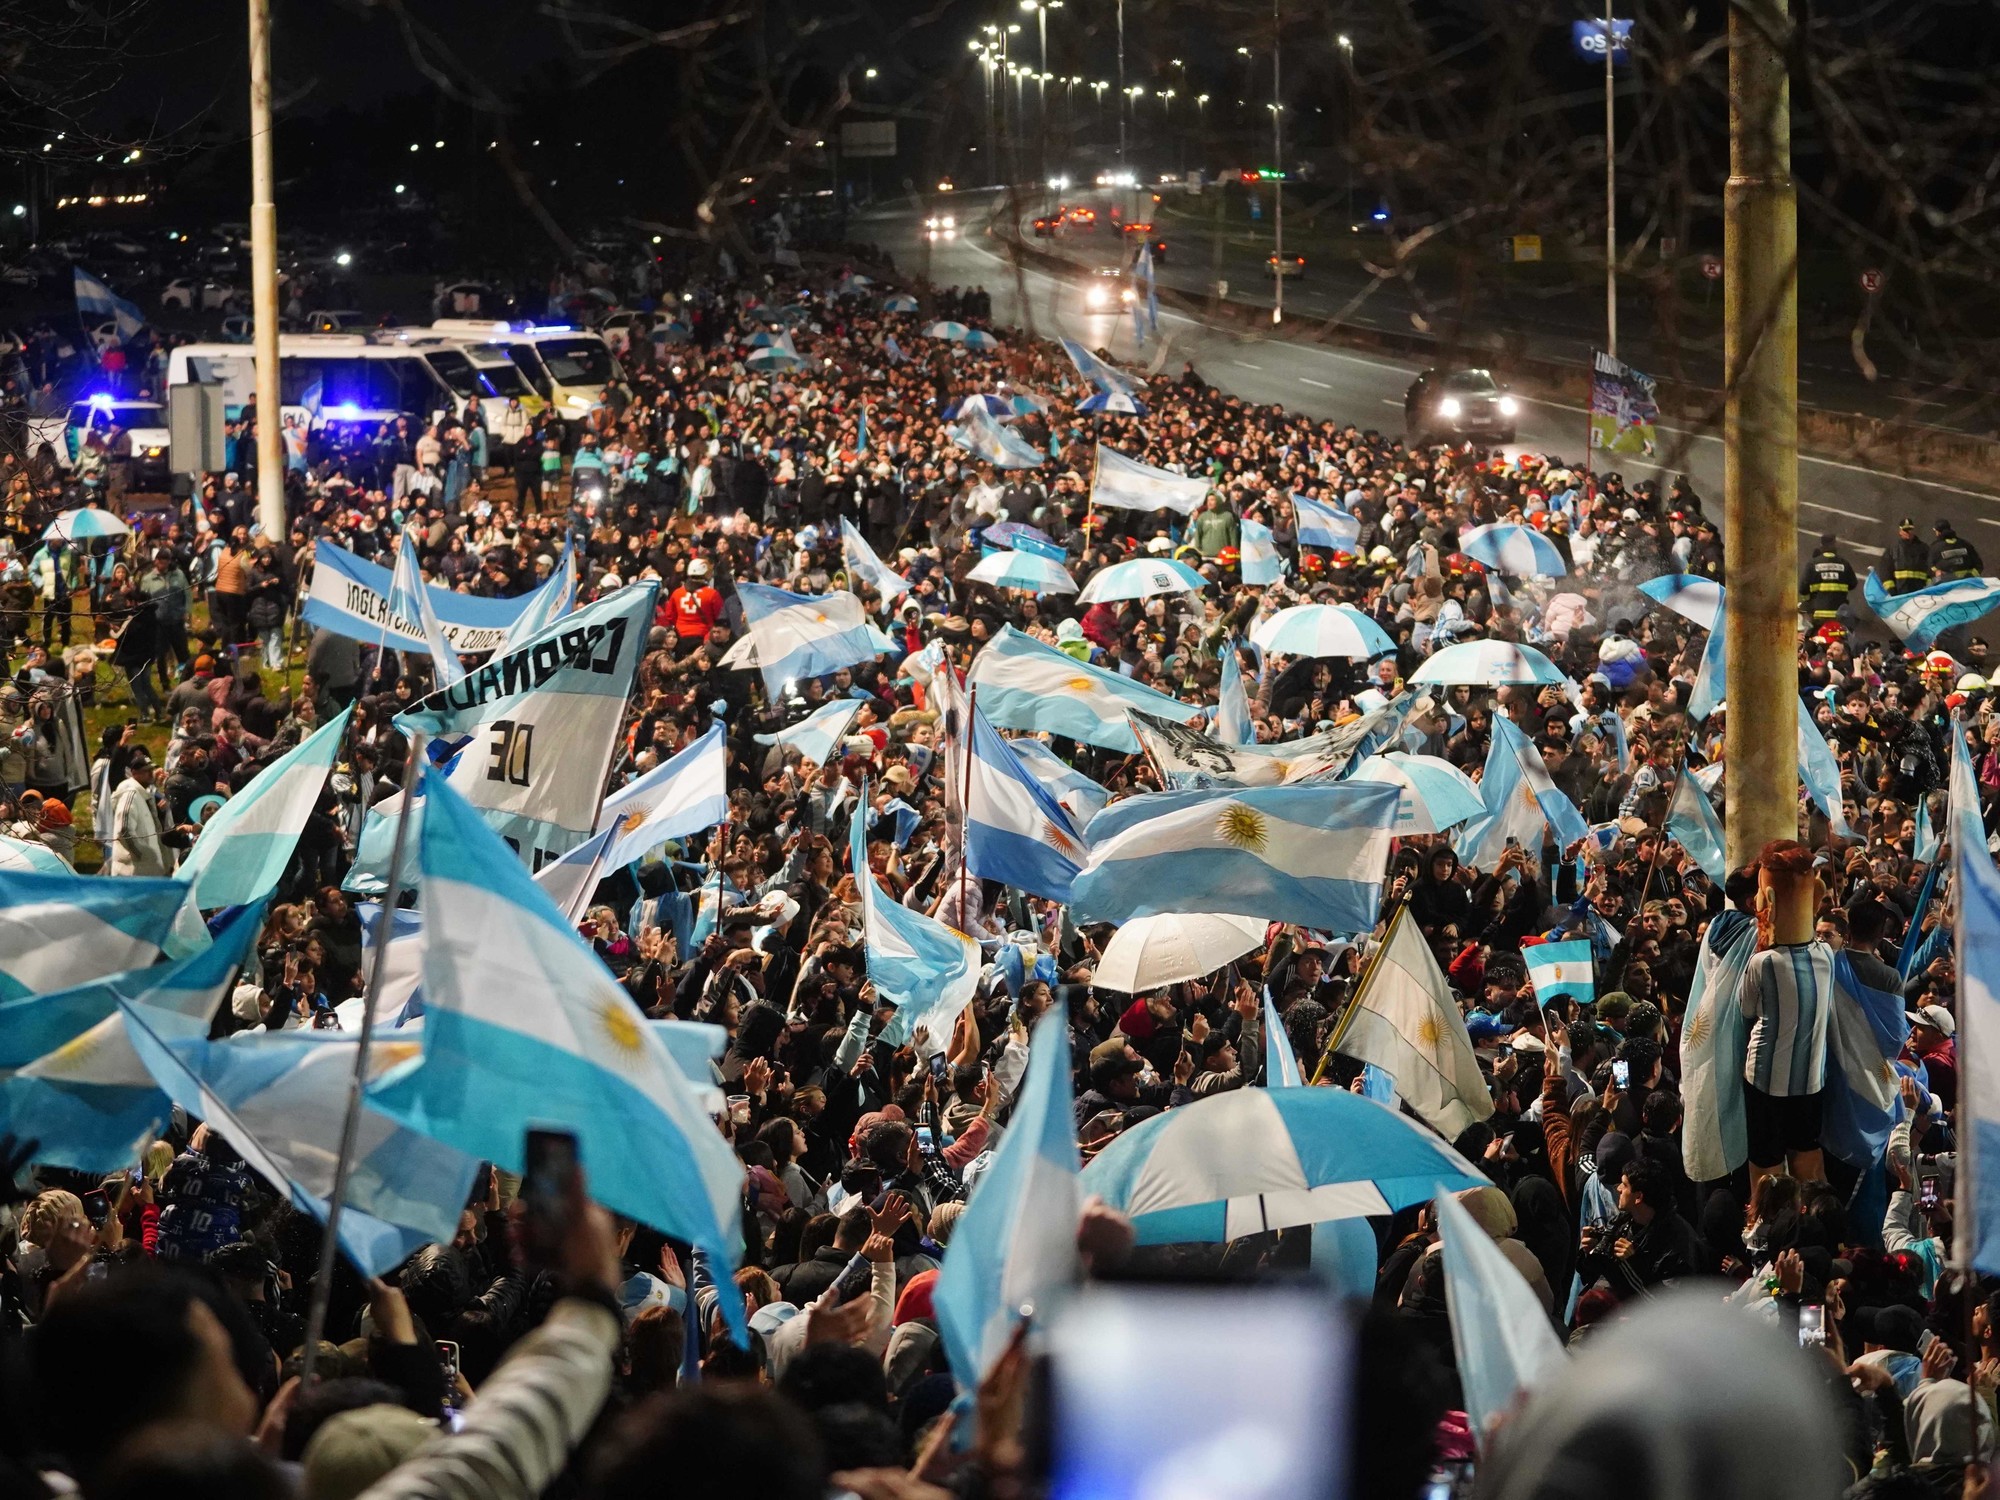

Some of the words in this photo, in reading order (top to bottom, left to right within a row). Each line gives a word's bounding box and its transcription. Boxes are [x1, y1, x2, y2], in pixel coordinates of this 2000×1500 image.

[460, 629, 508, 649] CONCH
[182, 1177, 203, 1197] 10
[189, 1209, 213, 1233] 10
